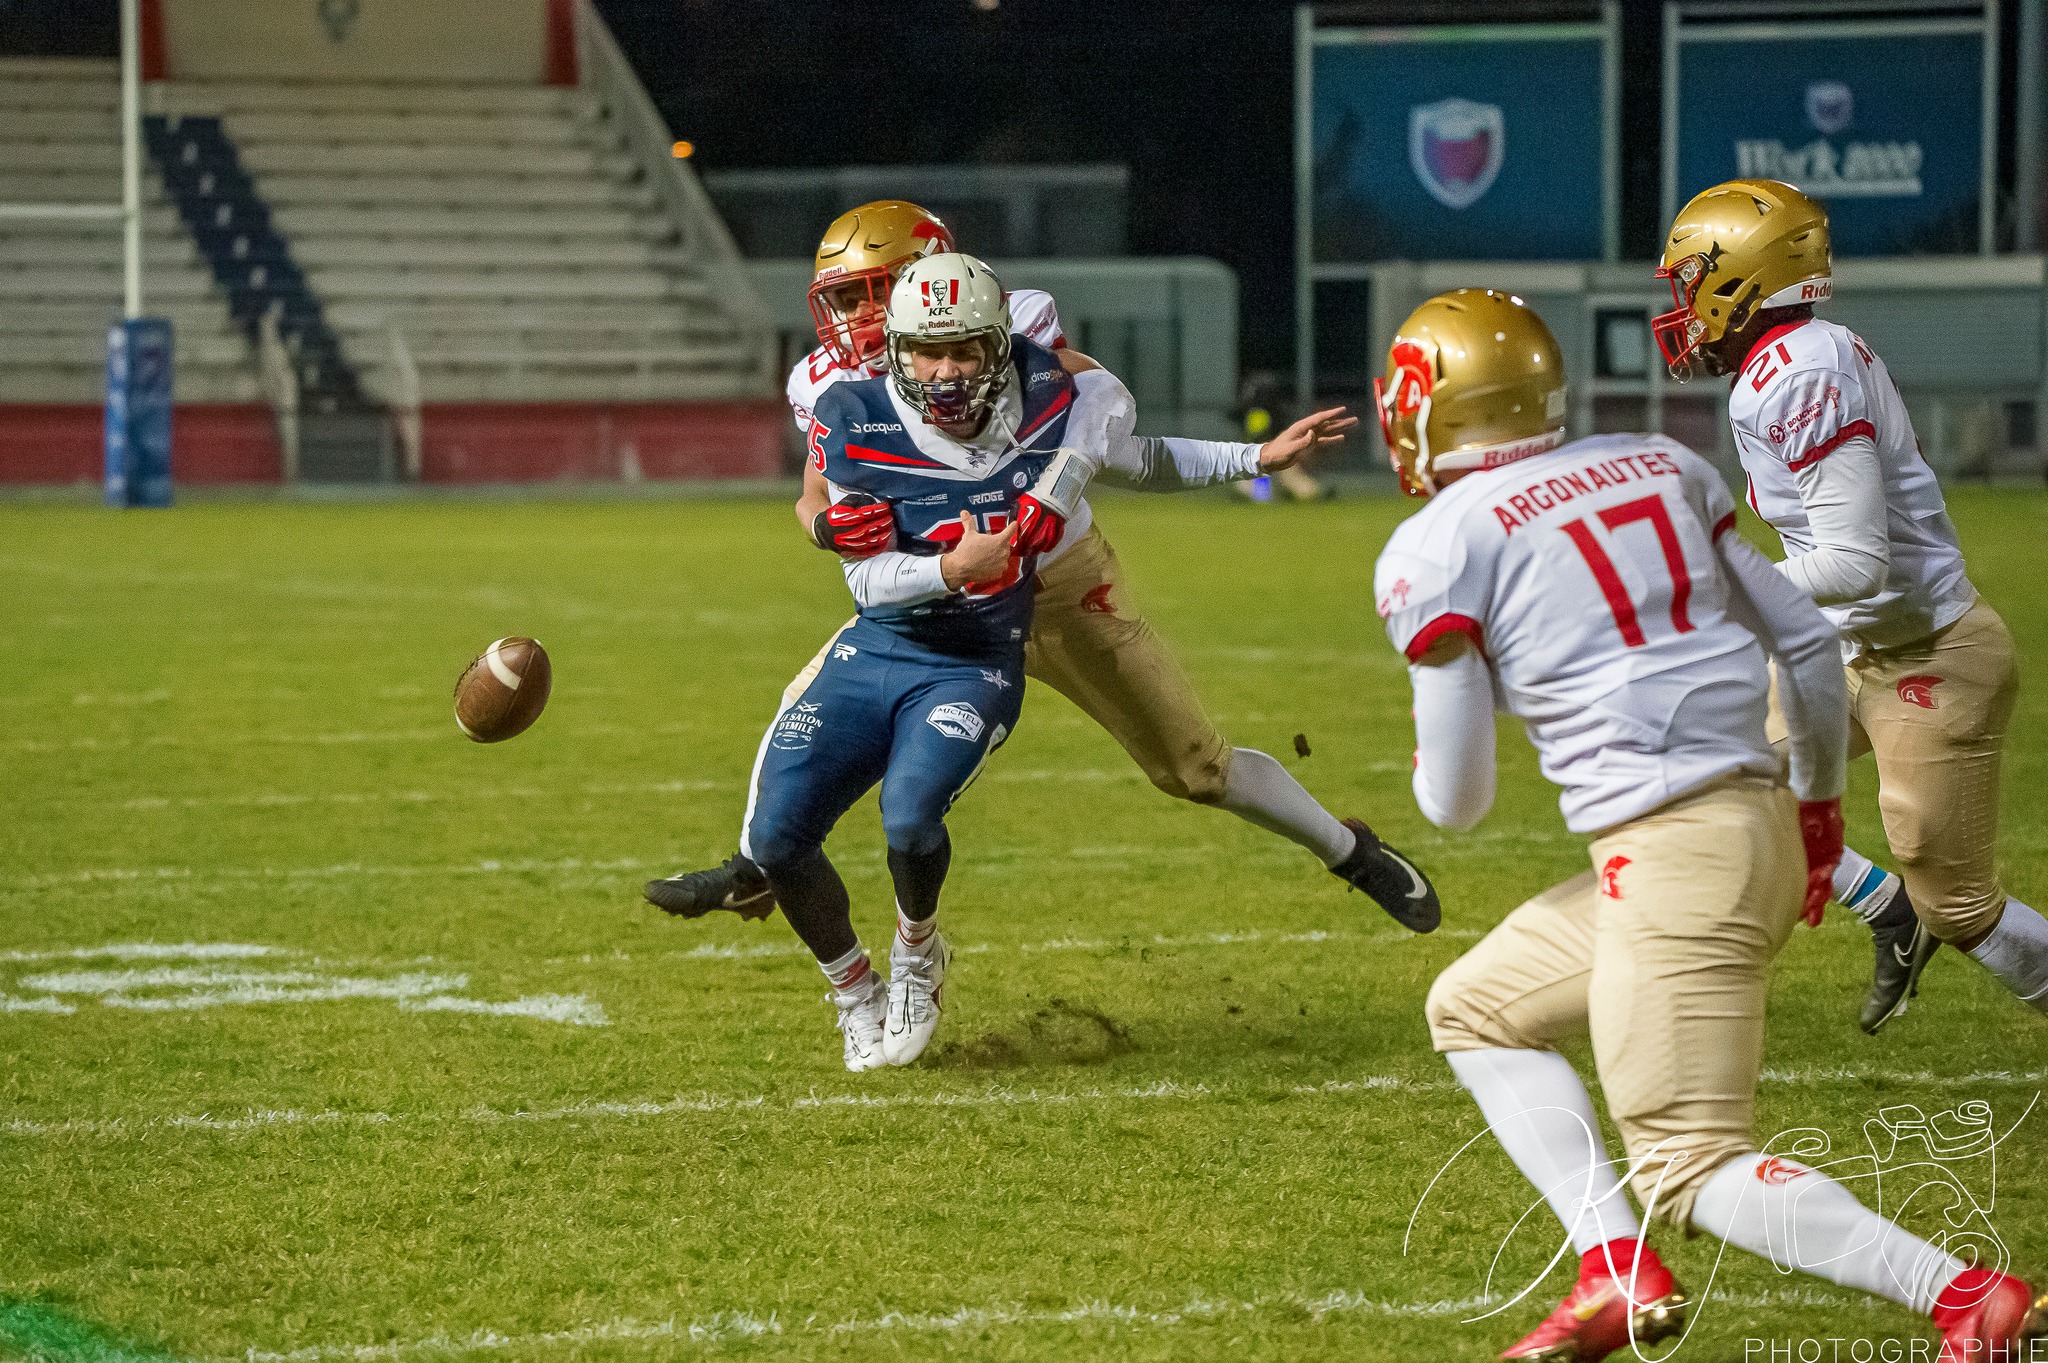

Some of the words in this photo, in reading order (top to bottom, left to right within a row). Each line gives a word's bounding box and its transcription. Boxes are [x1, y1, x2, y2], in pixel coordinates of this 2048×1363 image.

[928, 307, 953, 317] KFC
[928, 319, 955, 328] Riddell
[1747, 342, 1793, 393] 21
[862, 422, 903, 435] acqua
[1492, 452, 1682, 536] ARGONAUTES
[1559, 494, 1697, 648] 17
[789, 713, 823, 728] SALON
